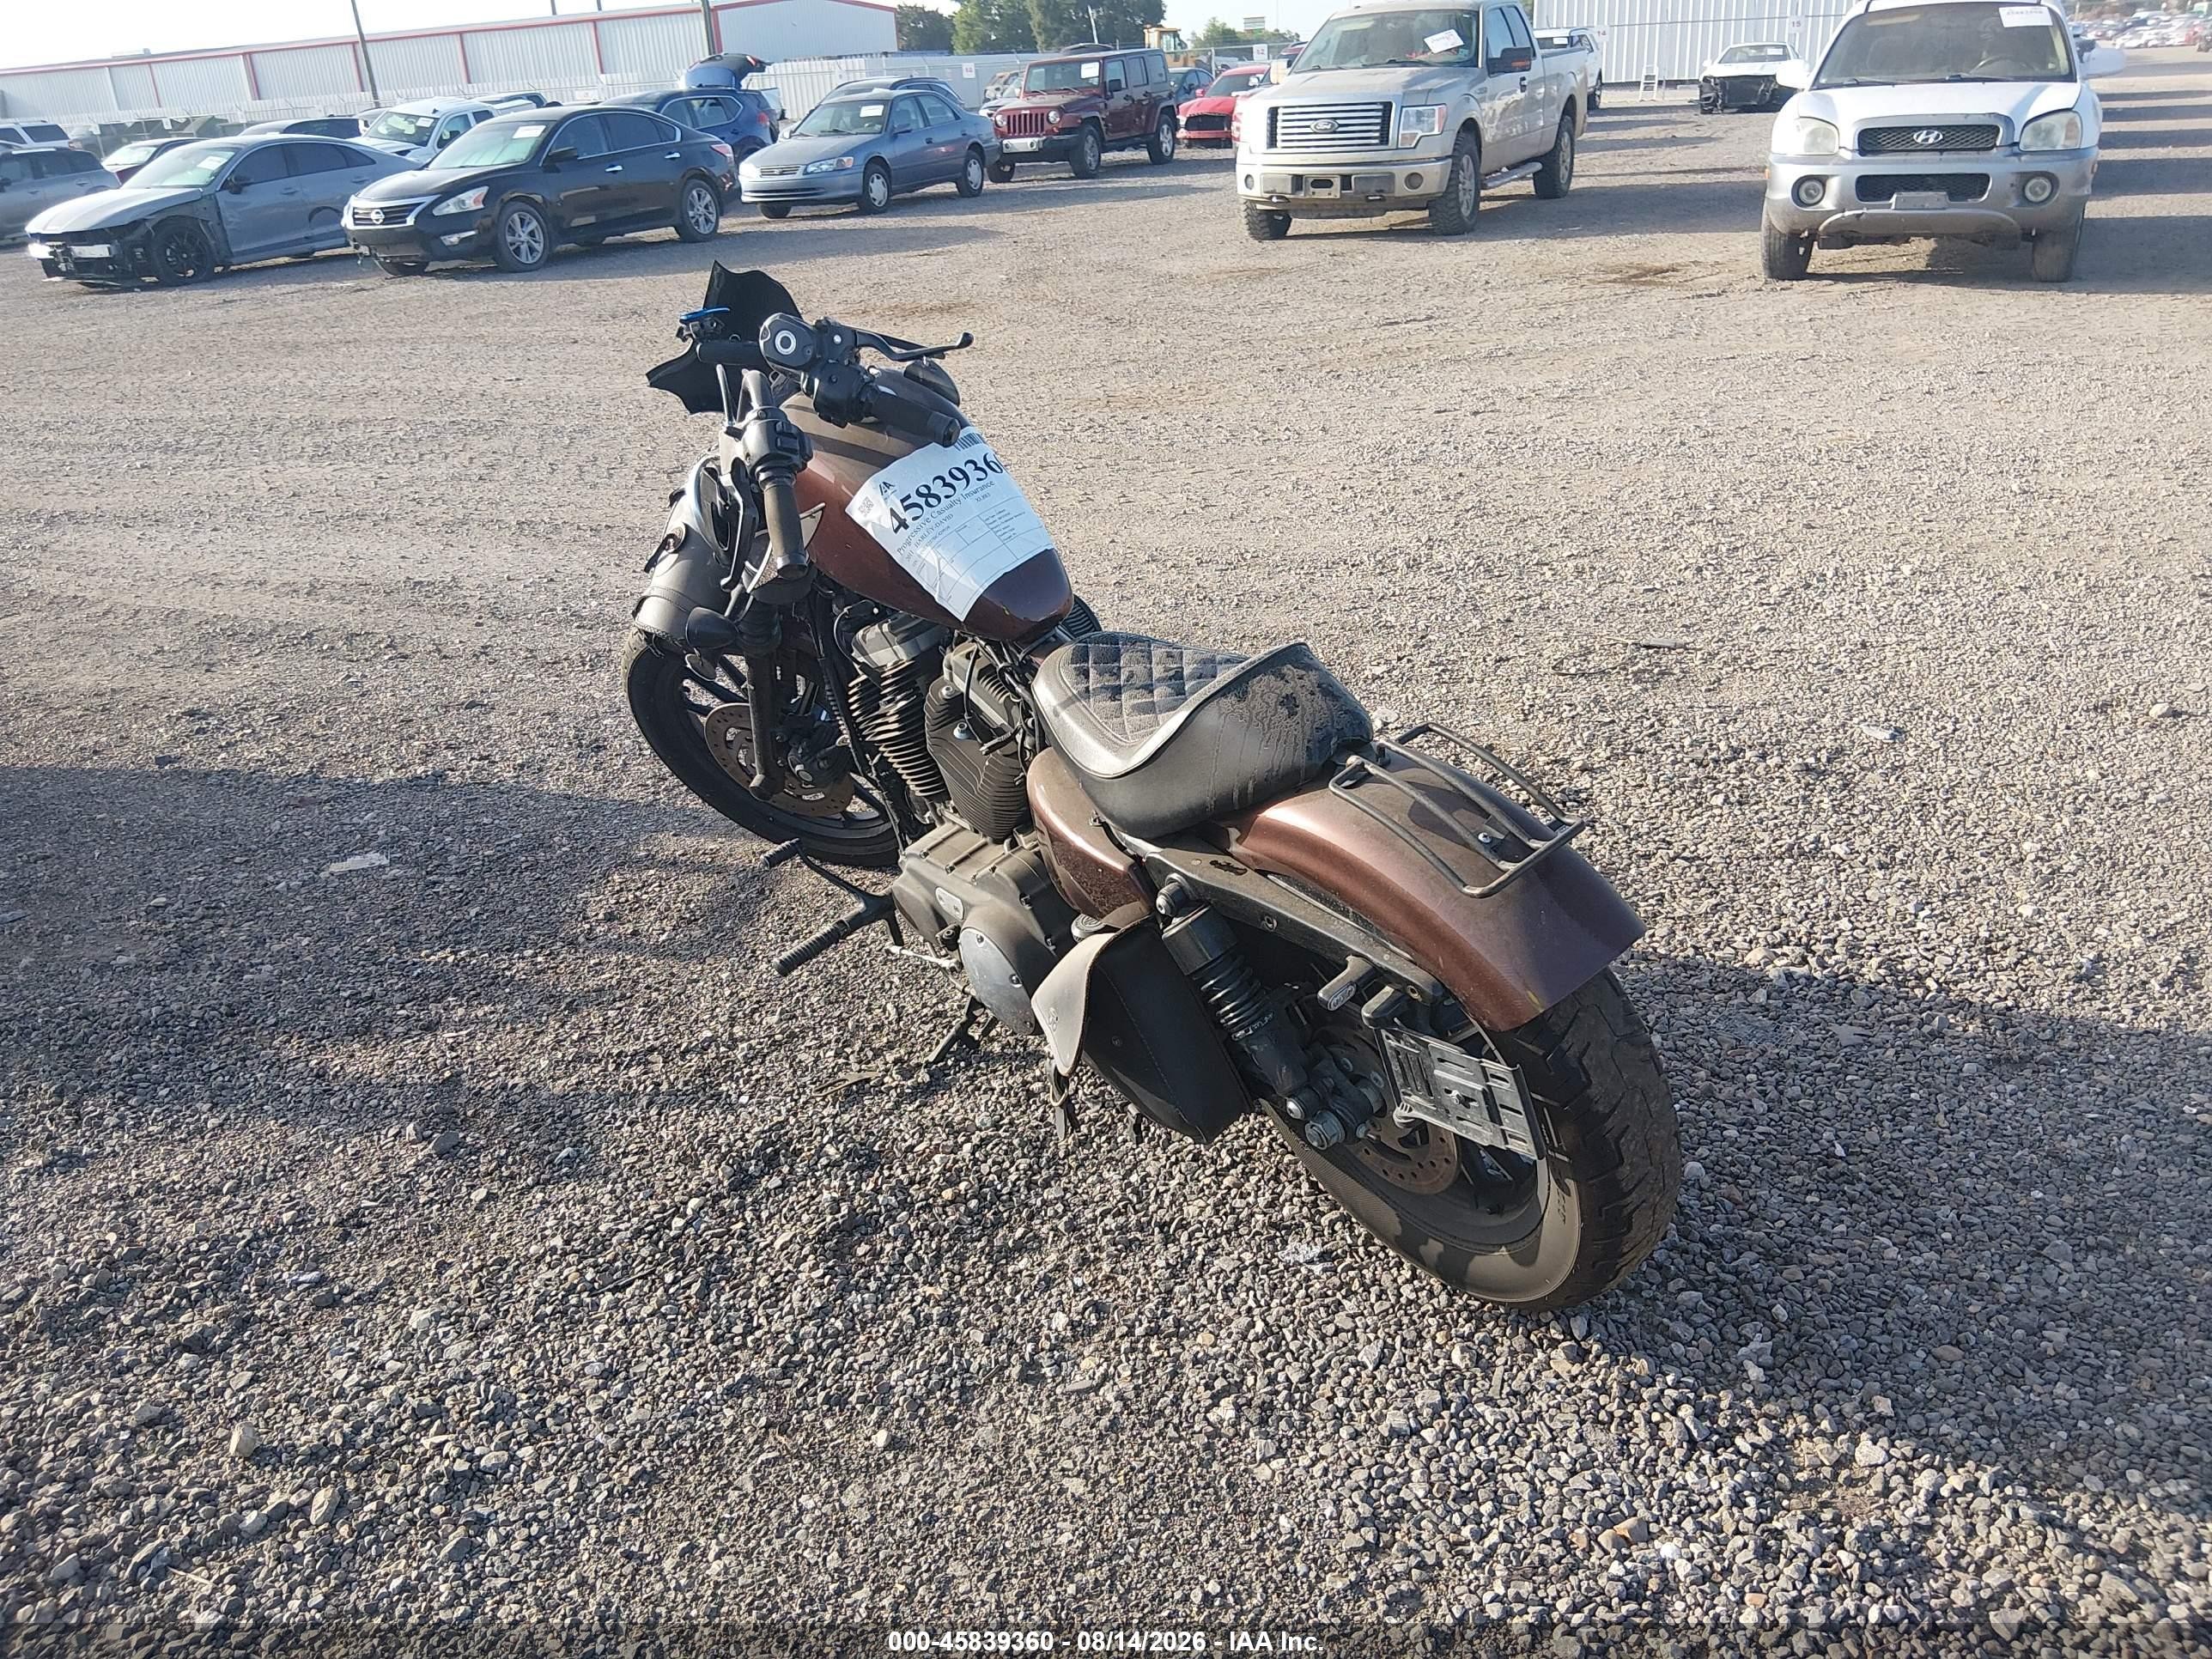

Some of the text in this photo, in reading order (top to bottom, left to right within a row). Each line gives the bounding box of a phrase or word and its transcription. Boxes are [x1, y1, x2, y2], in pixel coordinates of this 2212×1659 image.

[890, 452, 1005, 534] 4583936
[896, 517, 932, 556] Progressive
[930, 497, 963, 520] Casualty
[961, 480, 995, 501] Insurance
